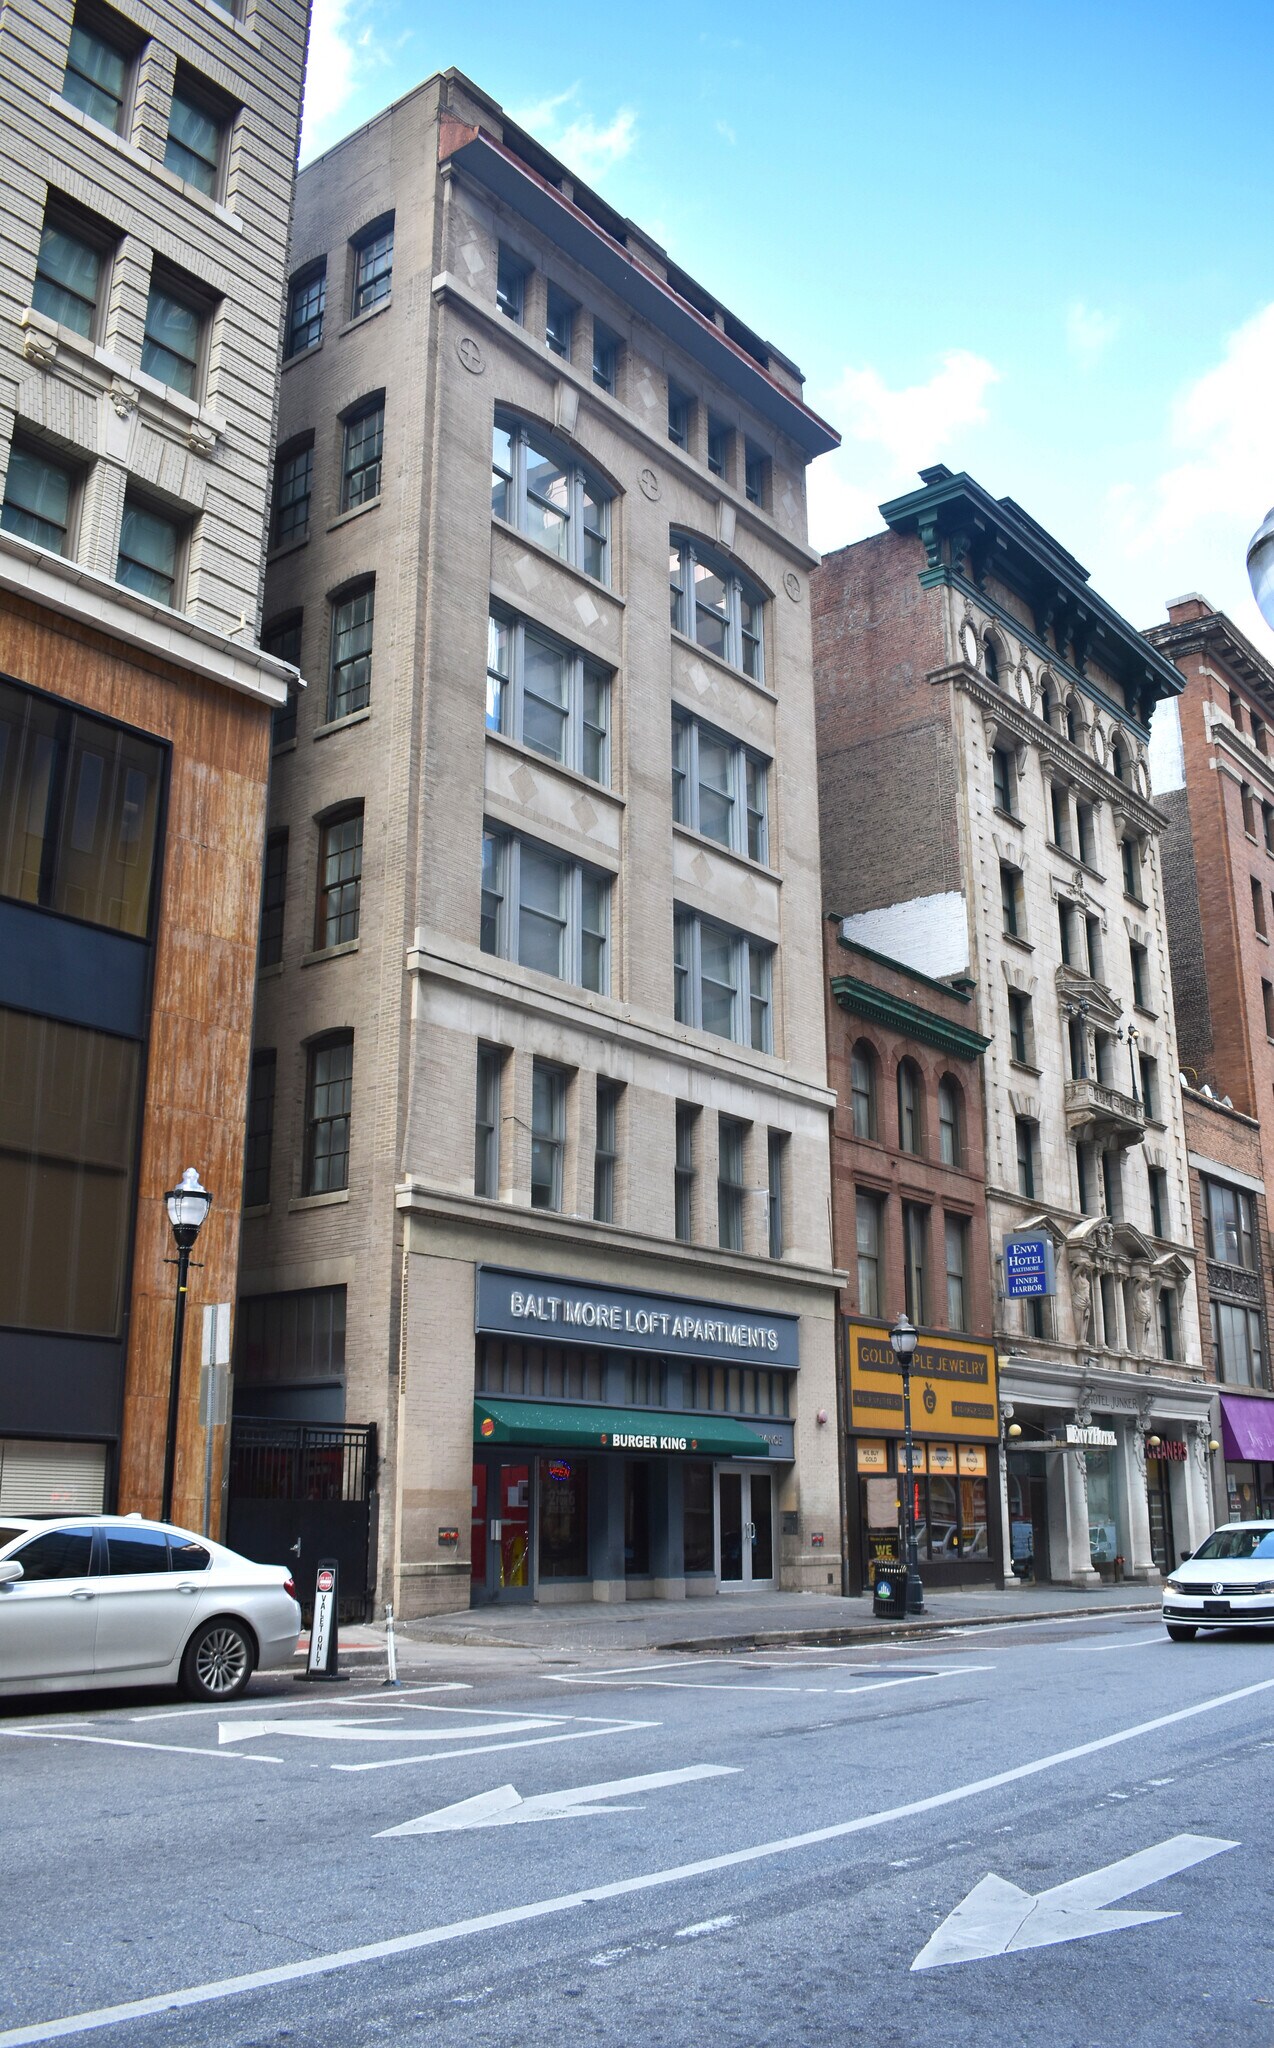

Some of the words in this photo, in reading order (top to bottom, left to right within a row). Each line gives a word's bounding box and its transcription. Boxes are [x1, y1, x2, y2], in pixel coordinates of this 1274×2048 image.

[1013, 1244, 1038, 1255] ENVY
[1009, 1256, 1043, 1267] HOTEL
[1012, 1284, 1042, 1293] HARBOR
[1015, 1277, 1038, 1285] INNER
[511, 1291, 622, 1330] BALTIMORE
[625, 1309, 671, 1335] LOFT
[672, 1316, 778, 1351] APARTMENTS
[861, 1347, 894, 1365] GOLD
[936, 1357, 985, 1375] JEWELRY
[612, 1434, 658, 1449] BURGER
[660, 1436, 687, 1450] KING
[1146, 1439, 1187, 1460] CLEANERS
[875, 1544, 892, 1556] WE
[319, 1594, 327, 1632] VALET
[315, 1635, 323, 1666] ONLY
